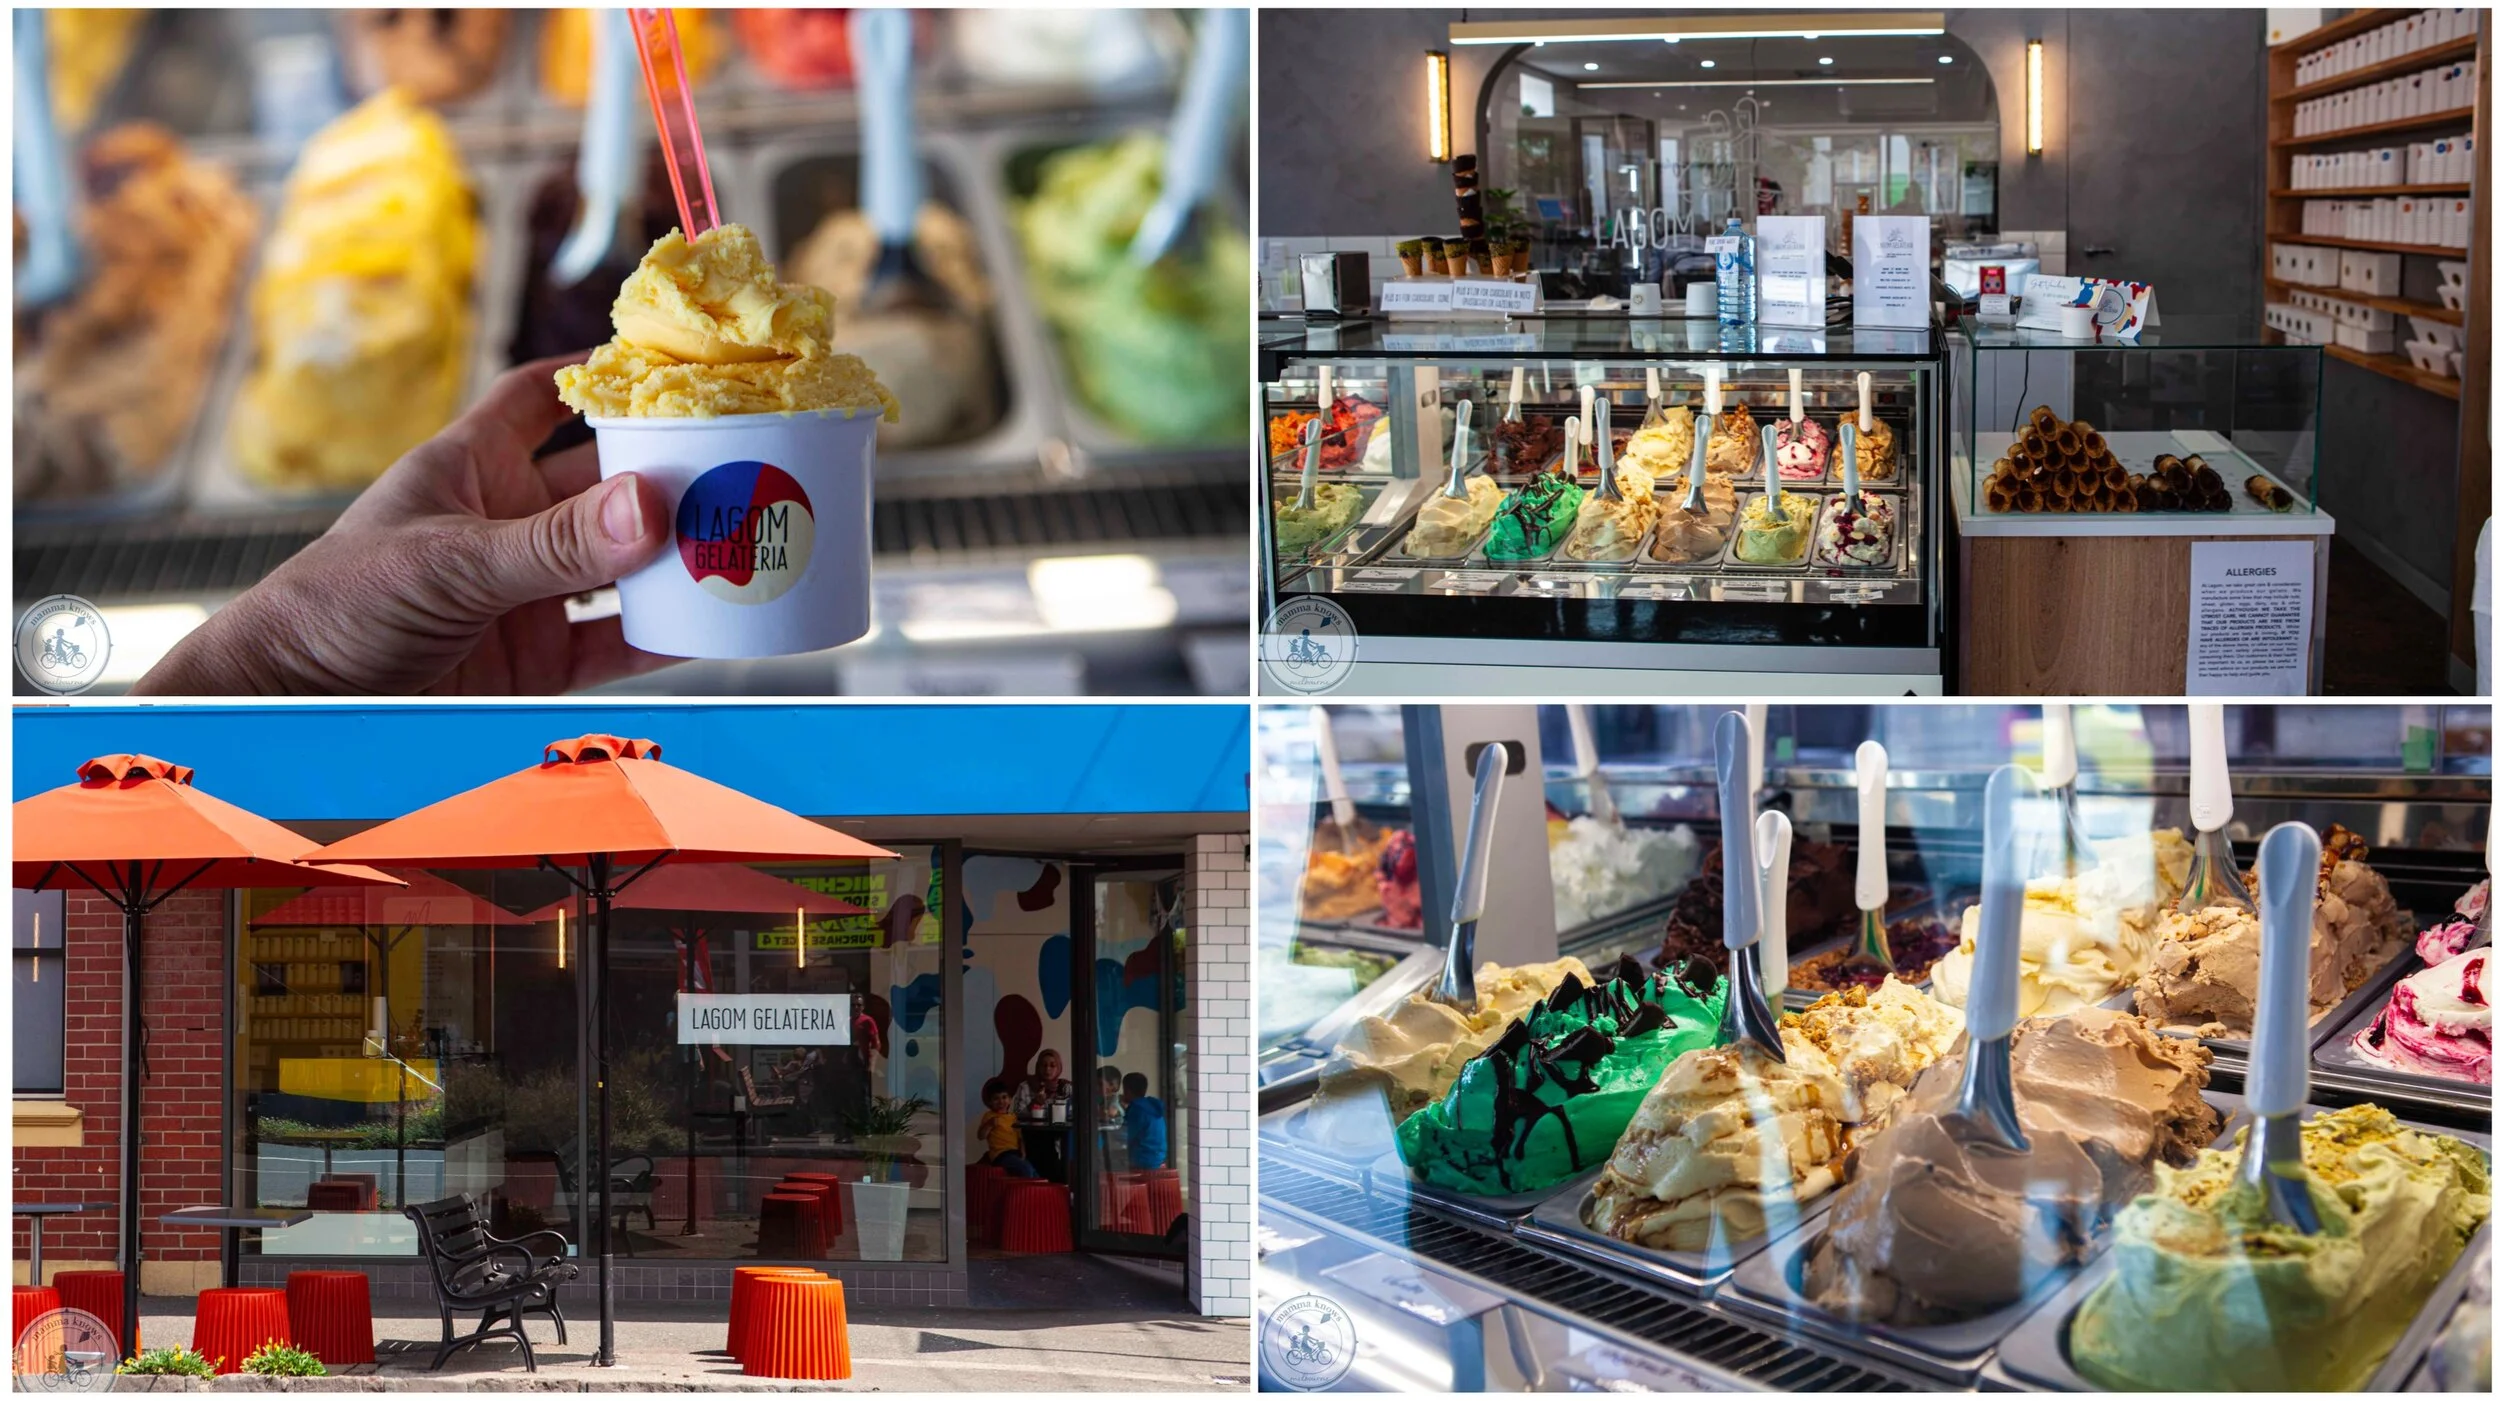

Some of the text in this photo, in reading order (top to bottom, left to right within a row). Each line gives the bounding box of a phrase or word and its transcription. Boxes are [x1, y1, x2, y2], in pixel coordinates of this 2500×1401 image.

[1595, 206, 1696, 250] LAGOM
[694, 504, 789, 544] LAGOM
[694, 543, 788, 571] GELATERIA
[2226, 568, 2277, 576] ALLERGIES
[692, 1008, 836, 1030] LAGOM GELATERIA
